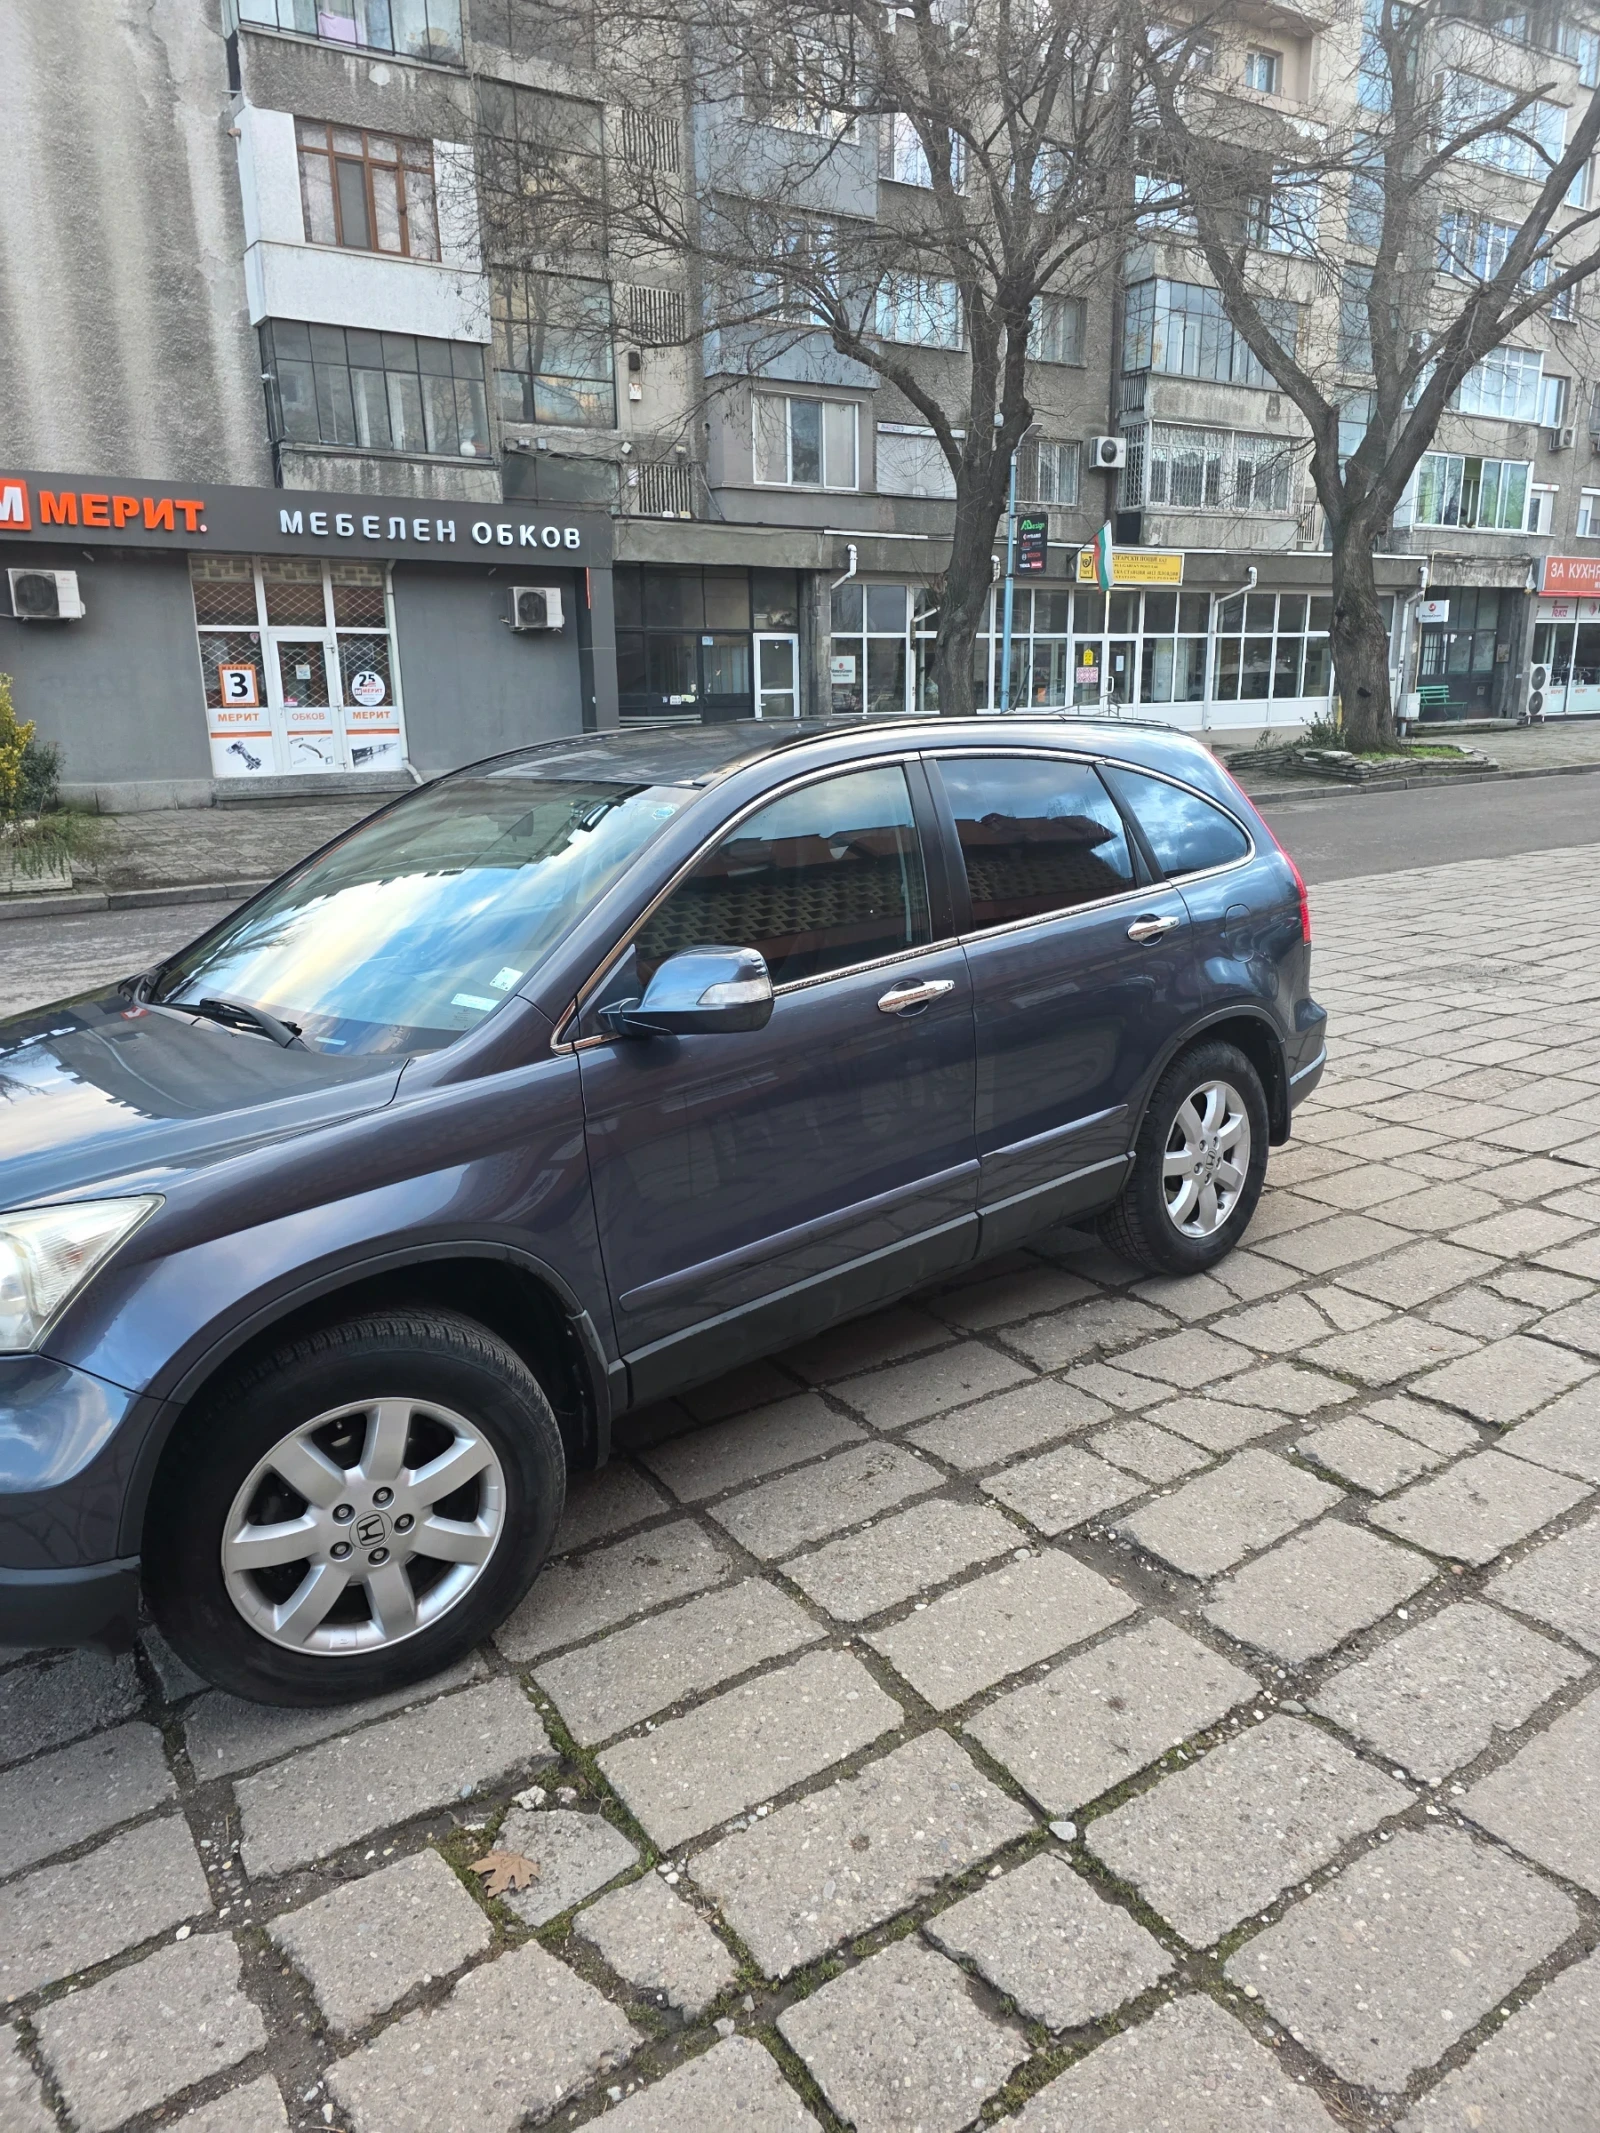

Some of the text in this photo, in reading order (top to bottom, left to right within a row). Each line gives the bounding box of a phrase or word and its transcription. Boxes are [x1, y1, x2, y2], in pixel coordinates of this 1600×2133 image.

[279, 509, 581, 549] МЕБЕЛЕН ОБКОВ
[1550, 562, 1564, 578] ЗА
[230, 672, 248, 698] 3
[359, 674, 376, 687] 25
[217, 713, 260, 722] МЕРИТ
[291, 712, 326, 721] ОБКОВ
[352, 711, 391, 719] МЕРИТ
